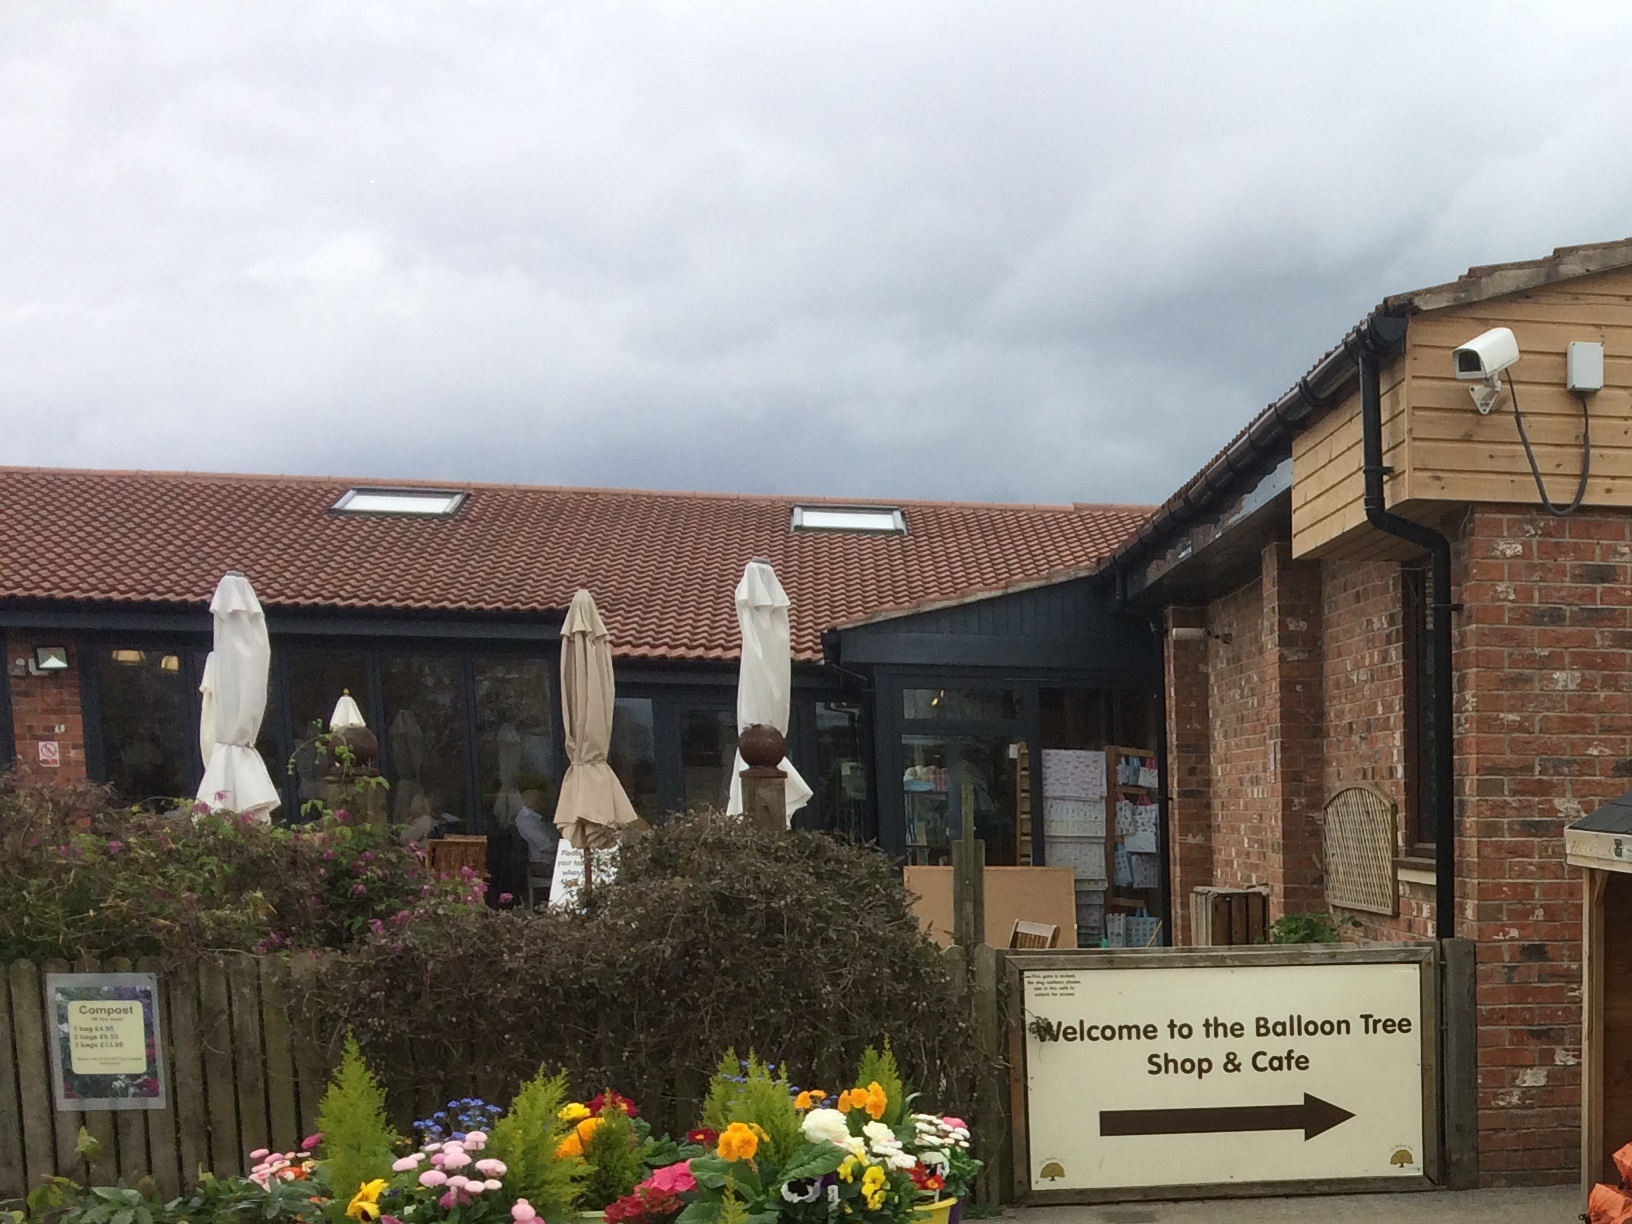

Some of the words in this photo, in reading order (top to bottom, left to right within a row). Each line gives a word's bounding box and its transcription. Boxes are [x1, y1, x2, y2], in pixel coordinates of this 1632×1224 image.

[78, 1005, 134, 1016] Compost
[1037, 1019, 1159, 1042] Welcome
[1167, 1018, 1194, 1039] to
[1202, 1016, 1245, 1038] the
[1255, 1014, 1351, 1038] Balloon
[1360, 1013, 1413, 1035] Tree
[1147, 1052, 1213, 1079] Shop
[1222, 1052, 1243, 1074] &
[1251, 1049, 1310, 1073] Cafe
